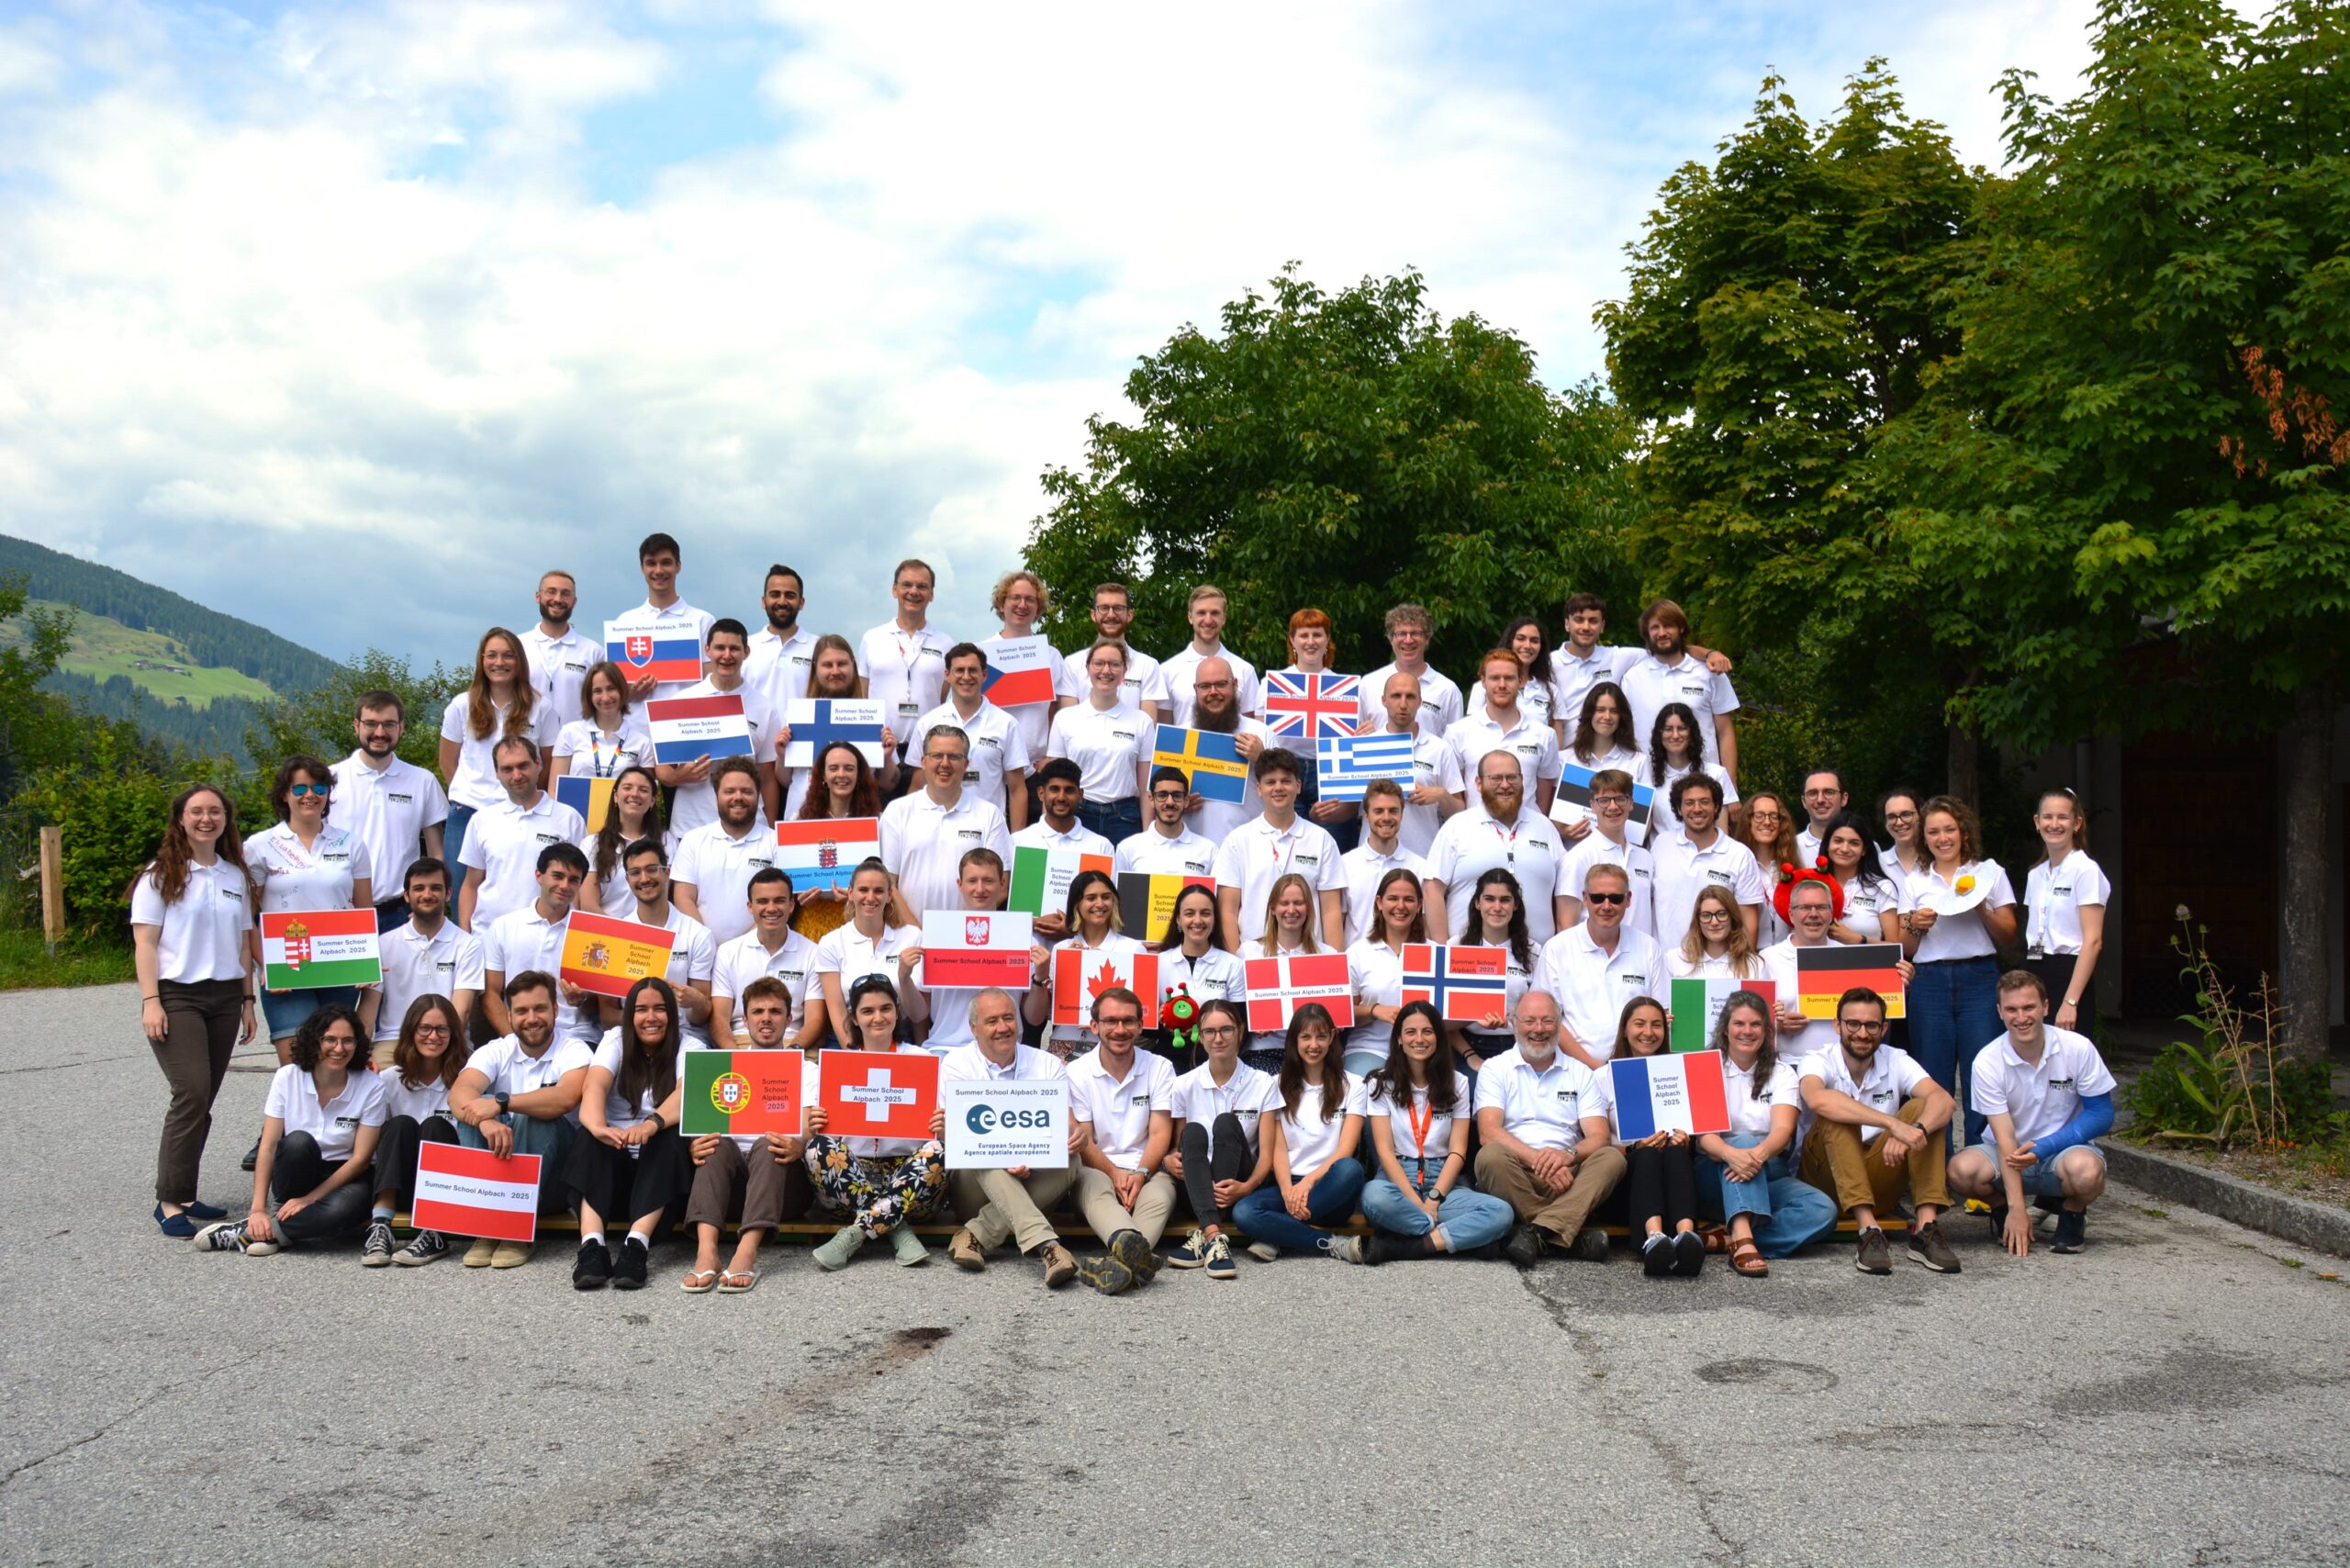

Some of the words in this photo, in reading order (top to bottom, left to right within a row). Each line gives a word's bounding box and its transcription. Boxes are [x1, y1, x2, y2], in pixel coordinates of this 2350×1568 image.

[630, 944, 654, 953] Summer
[630, 951, 651, 959] School
[626, 958, 651, 967] Alpbach
[1001, 1110, 1050, 1128] esa
[425, 1181, 452, 1190] Summer
[453, 1184, 476, 1193] School
[477, 1189, 505, 1198] Alpbach
